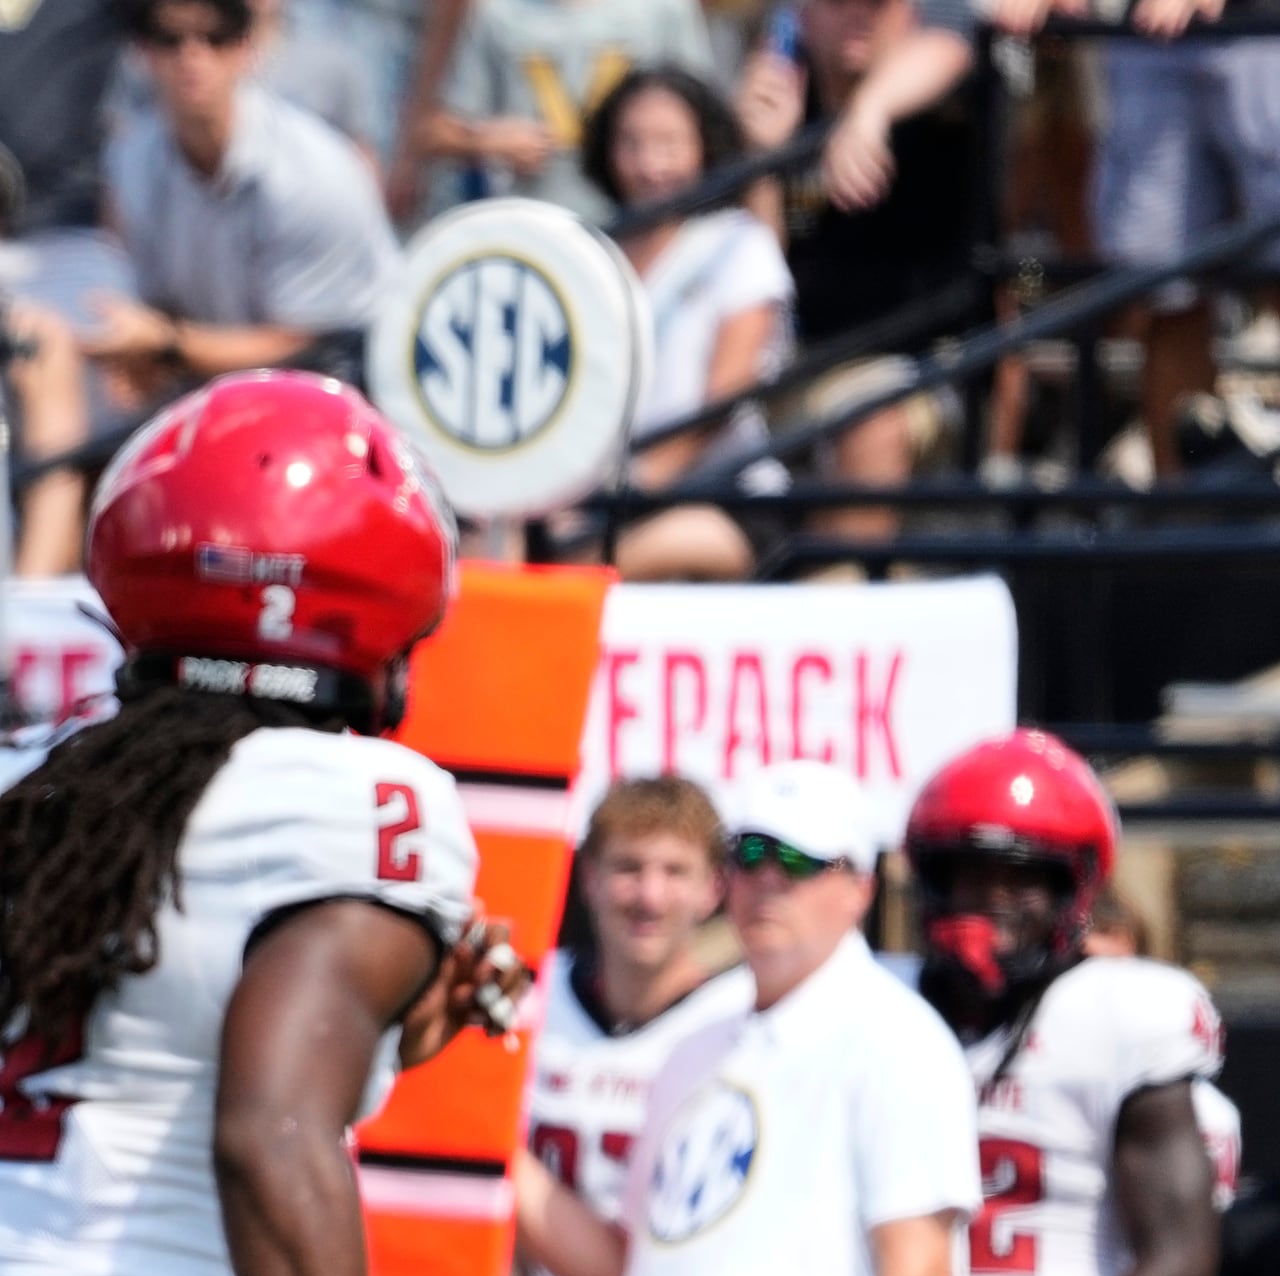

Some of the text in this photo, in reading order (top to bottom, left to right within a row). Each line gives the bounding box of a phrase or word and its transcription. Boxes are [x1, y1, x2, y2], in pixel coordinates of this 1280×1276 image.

[416, 260, 570, 443] SEC
[258, 583, 296, 642] 2
[374, 782, 422, 881] 2
